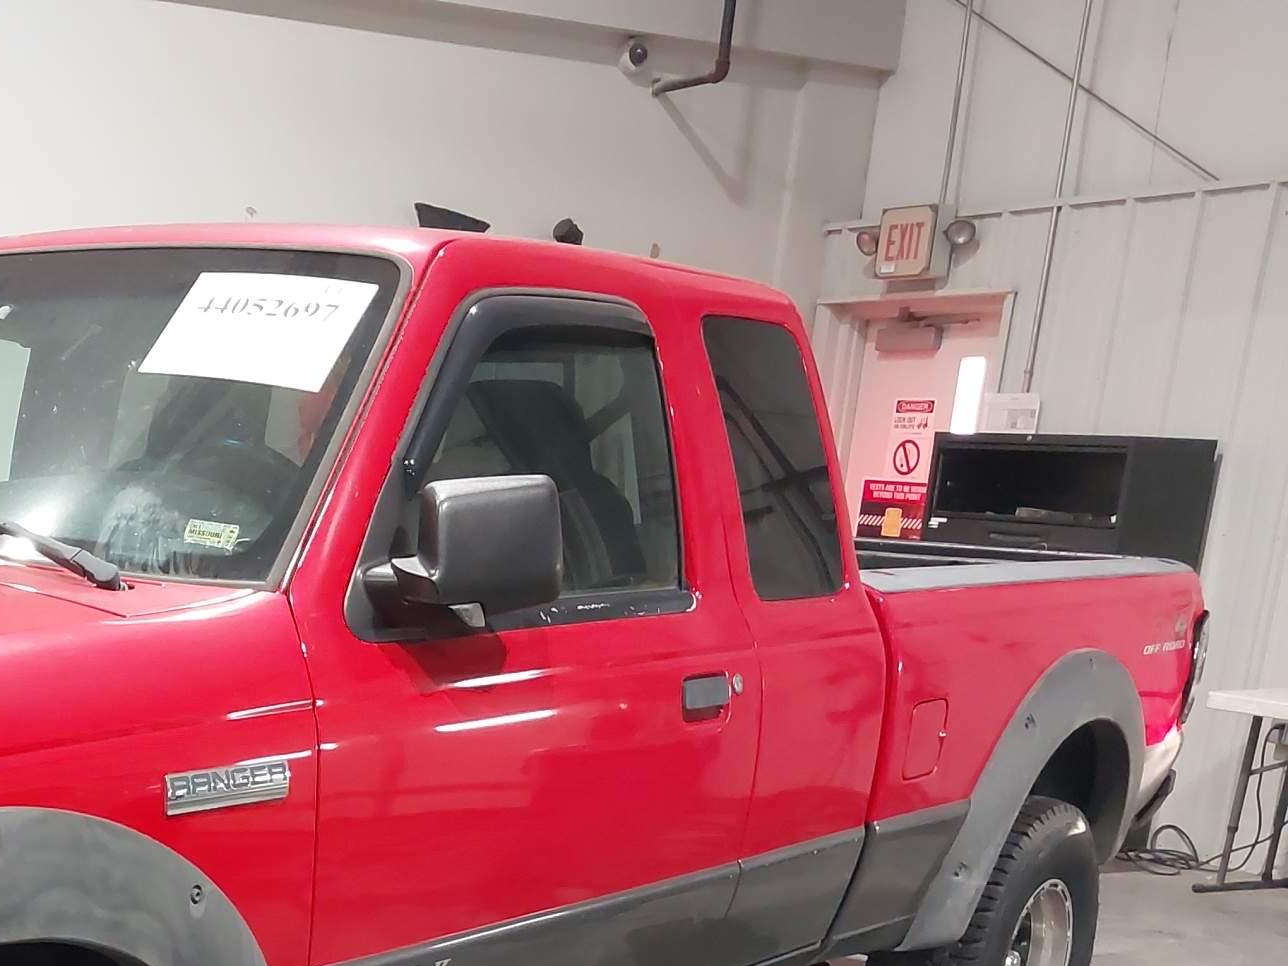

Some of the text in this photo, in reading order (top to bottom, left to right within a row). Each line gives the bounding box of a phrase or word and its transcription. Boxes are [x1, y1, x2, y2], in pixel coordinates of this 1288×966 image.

[885, 222, 925, 261] EXIT
[197, 297, 341, 321] 44052697
[1144, 640, 1185, 655] OFF ROAD
[168, 762, 289, 800] RANGER
